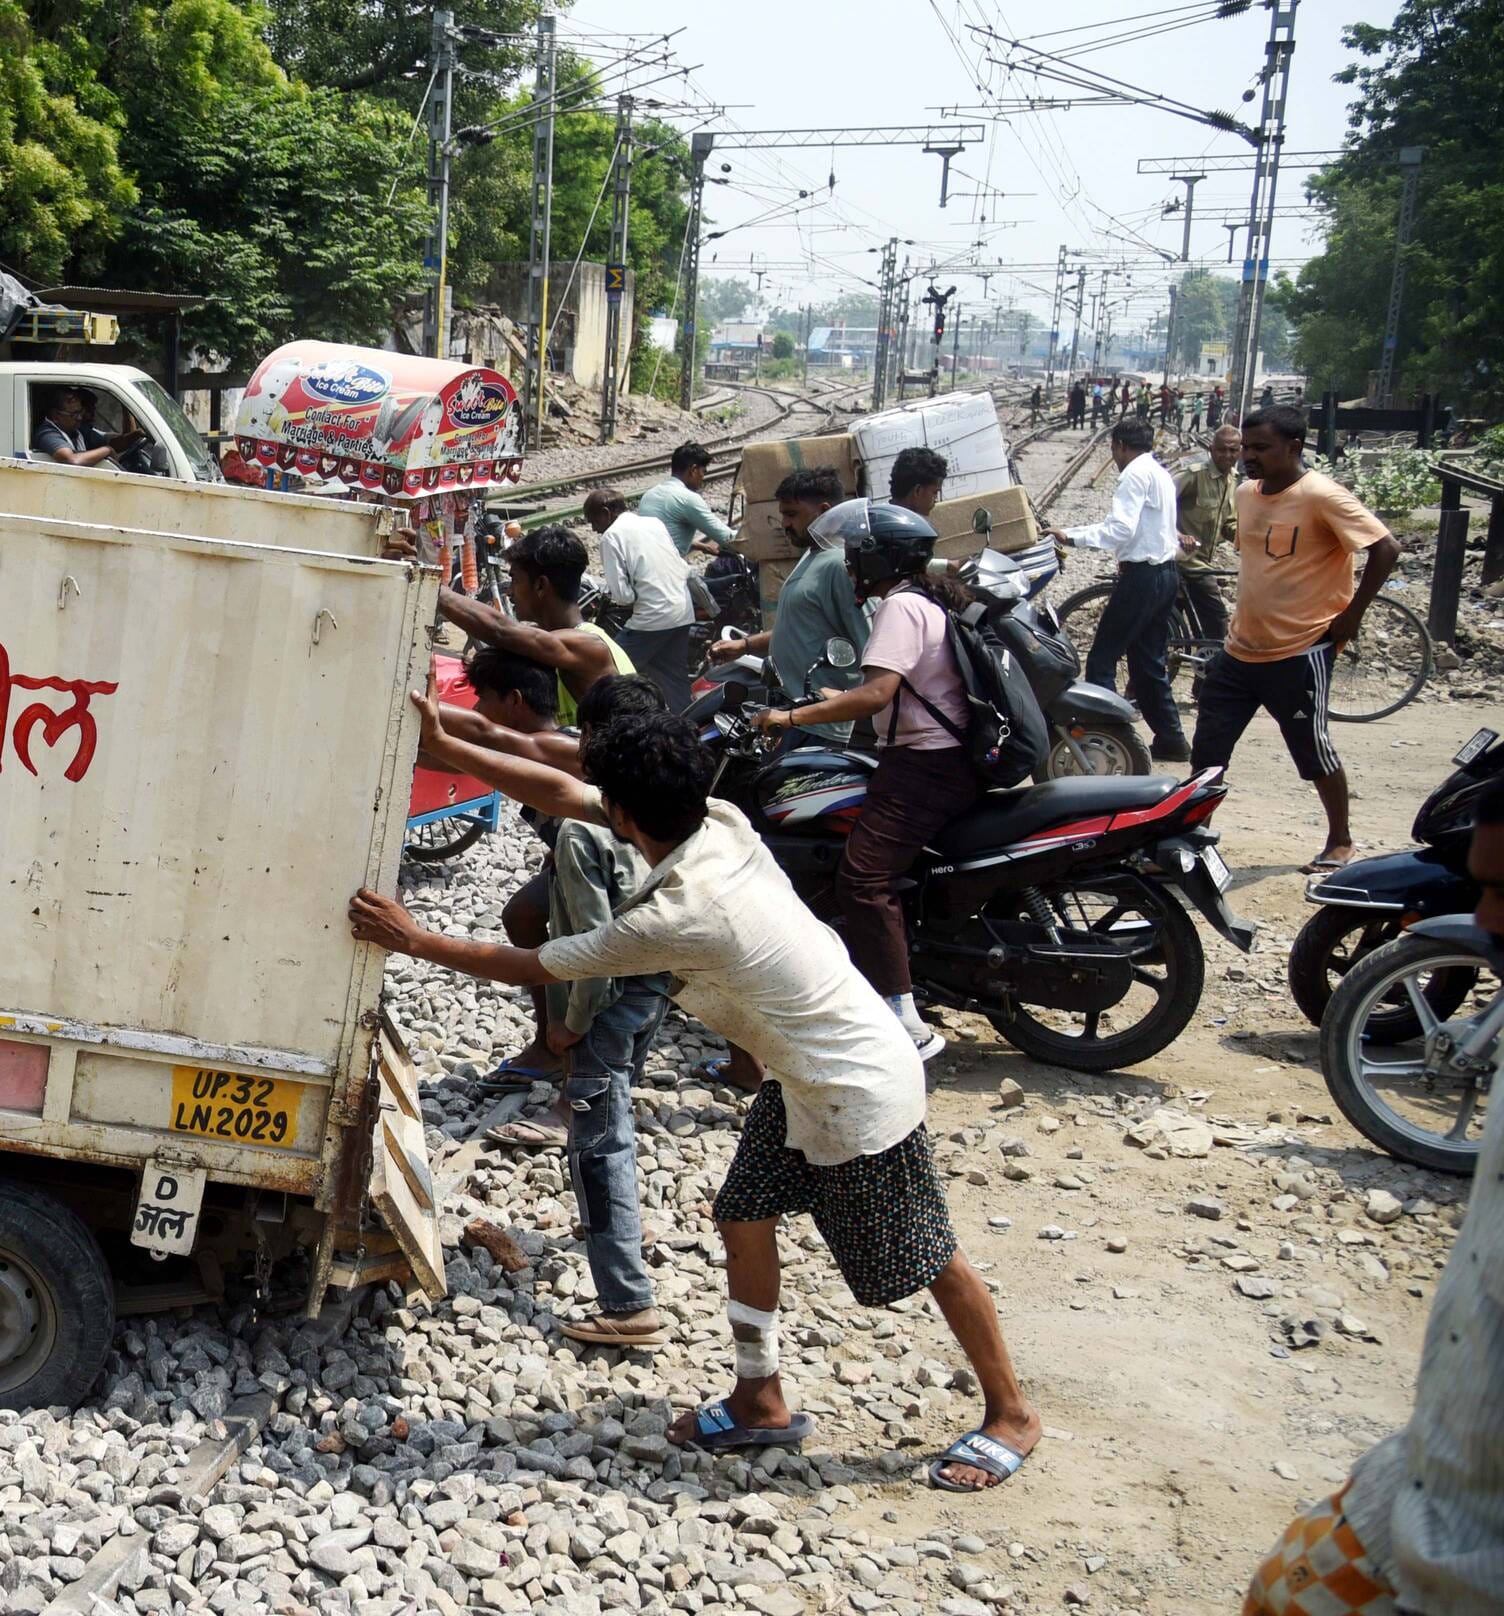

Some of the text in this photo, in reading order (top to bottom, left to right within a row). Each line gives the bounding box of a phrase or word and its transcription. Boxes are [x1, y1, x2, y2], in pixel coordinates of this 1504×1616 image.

[315, 380, 359, 399] Ice Cream
[305, 407, 361, 431] Contact For
[281, 421, 374, 455] Marriage & Parties
[193, 1071, 275, 1107] UP.32
[175, 1103, 288, 1142] LN.2029
[155, 1176, 178, 1200] D
[135, 1203, 194, 1239] जल
